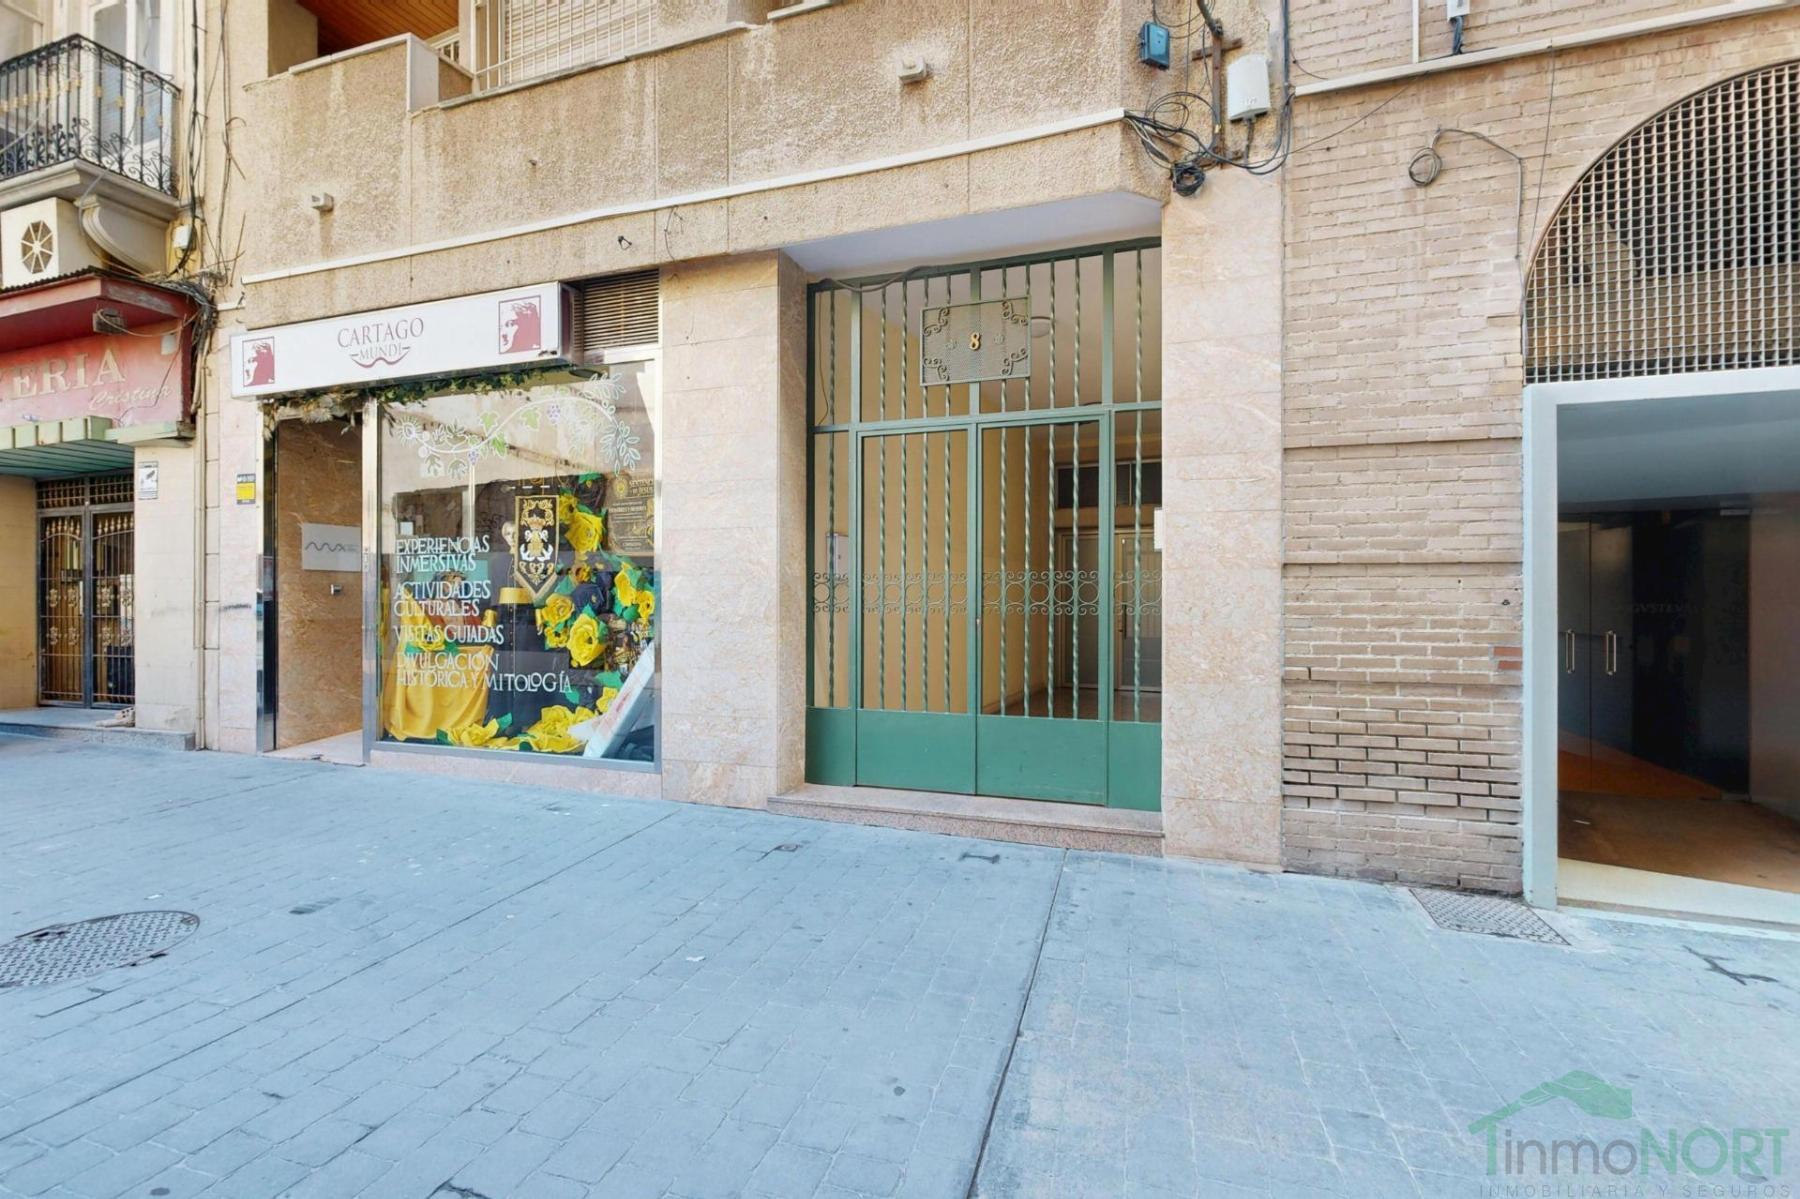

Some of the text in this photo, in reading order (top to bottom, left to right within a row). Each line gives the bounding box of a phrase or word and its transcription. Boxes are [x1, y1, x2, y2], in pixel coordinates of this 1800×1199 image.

[337, 317, 424, 348] CARTAGO
[969, 332, 982, 351] 8
[360, 343, 402, 361] MUNDI
[0, 348, 126, 401] ERIA
[395, 535, 490, 555] EXPERIENCIAS
[396, 553, 476, 574] INMERSIVAS
[393, 580, 491, 600] ACTIVIDADES
[393, 599, 480, 617] CULTURALES
[393, 624, 504, 645] VISITAS GUIADAS
[470, 671, 481, 689] Y
[482, 670, 572, 693] MITOLOGÍA
